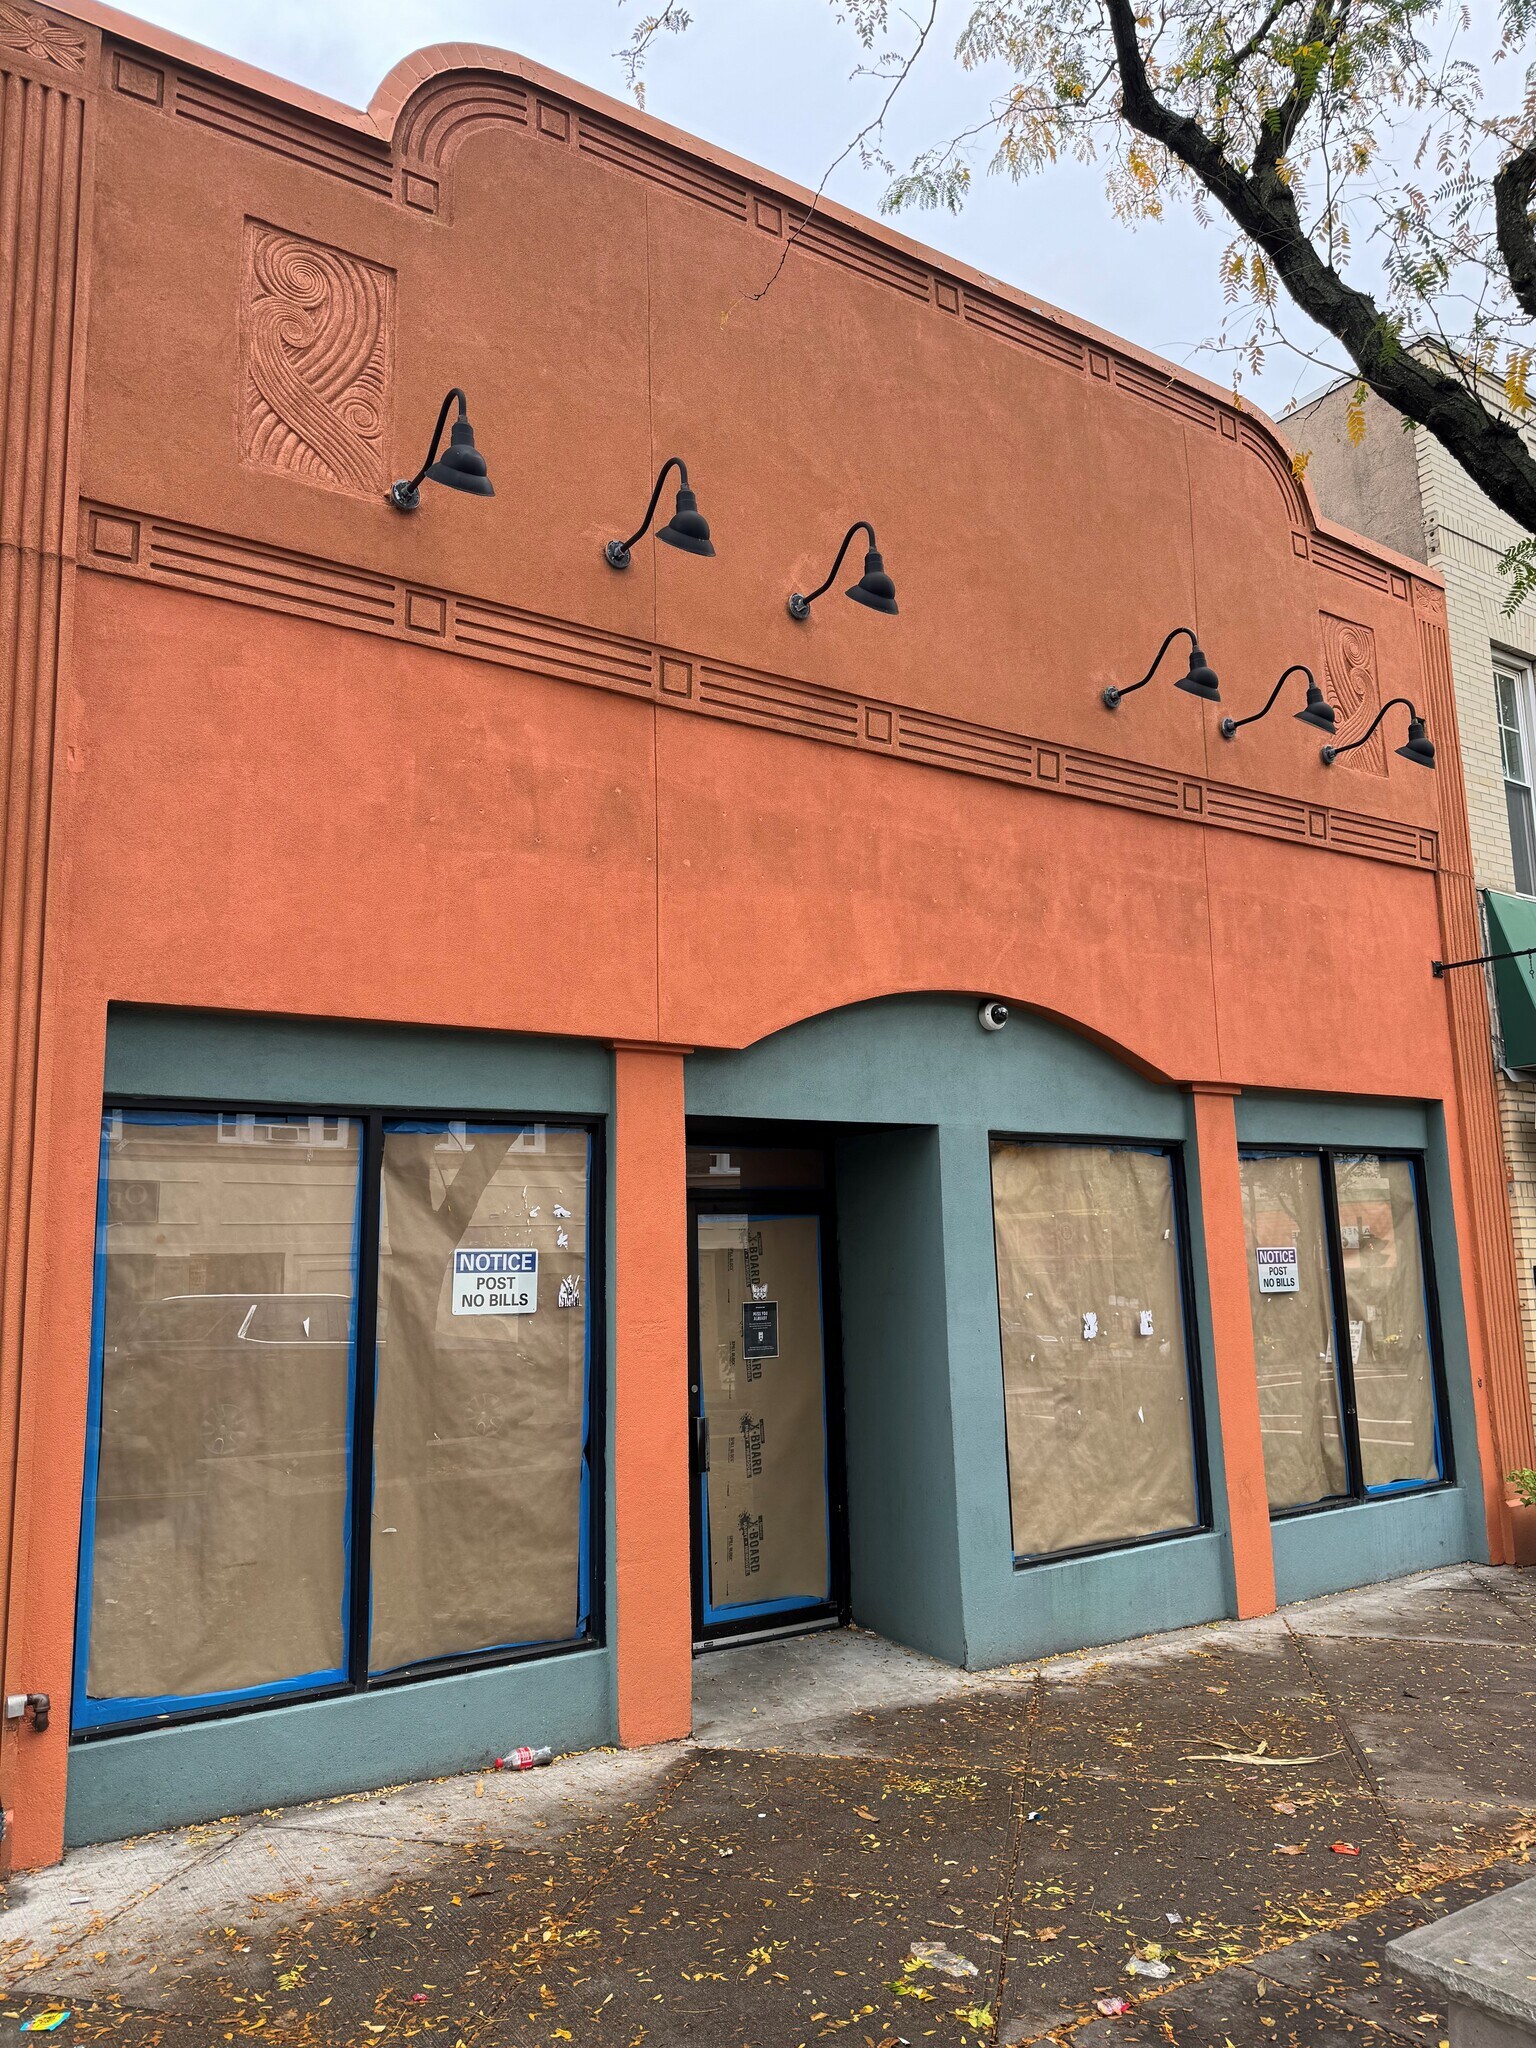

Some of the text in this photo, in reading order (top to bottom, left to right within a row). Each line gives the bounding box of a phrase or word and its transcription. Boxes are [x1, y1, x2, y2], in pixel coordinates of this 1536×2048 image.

[460, 1253, 533, 1272] NOTICE
[1259, 1250, 1295, 1263] NOTICE
[1268, 1266, 1287, 1275] POST
[476, 1276, 516, 1290] POST
[1263, 1277, 1296, 1288] NO BILLS
[462, 1293, 529, 1308] NO BILLS
